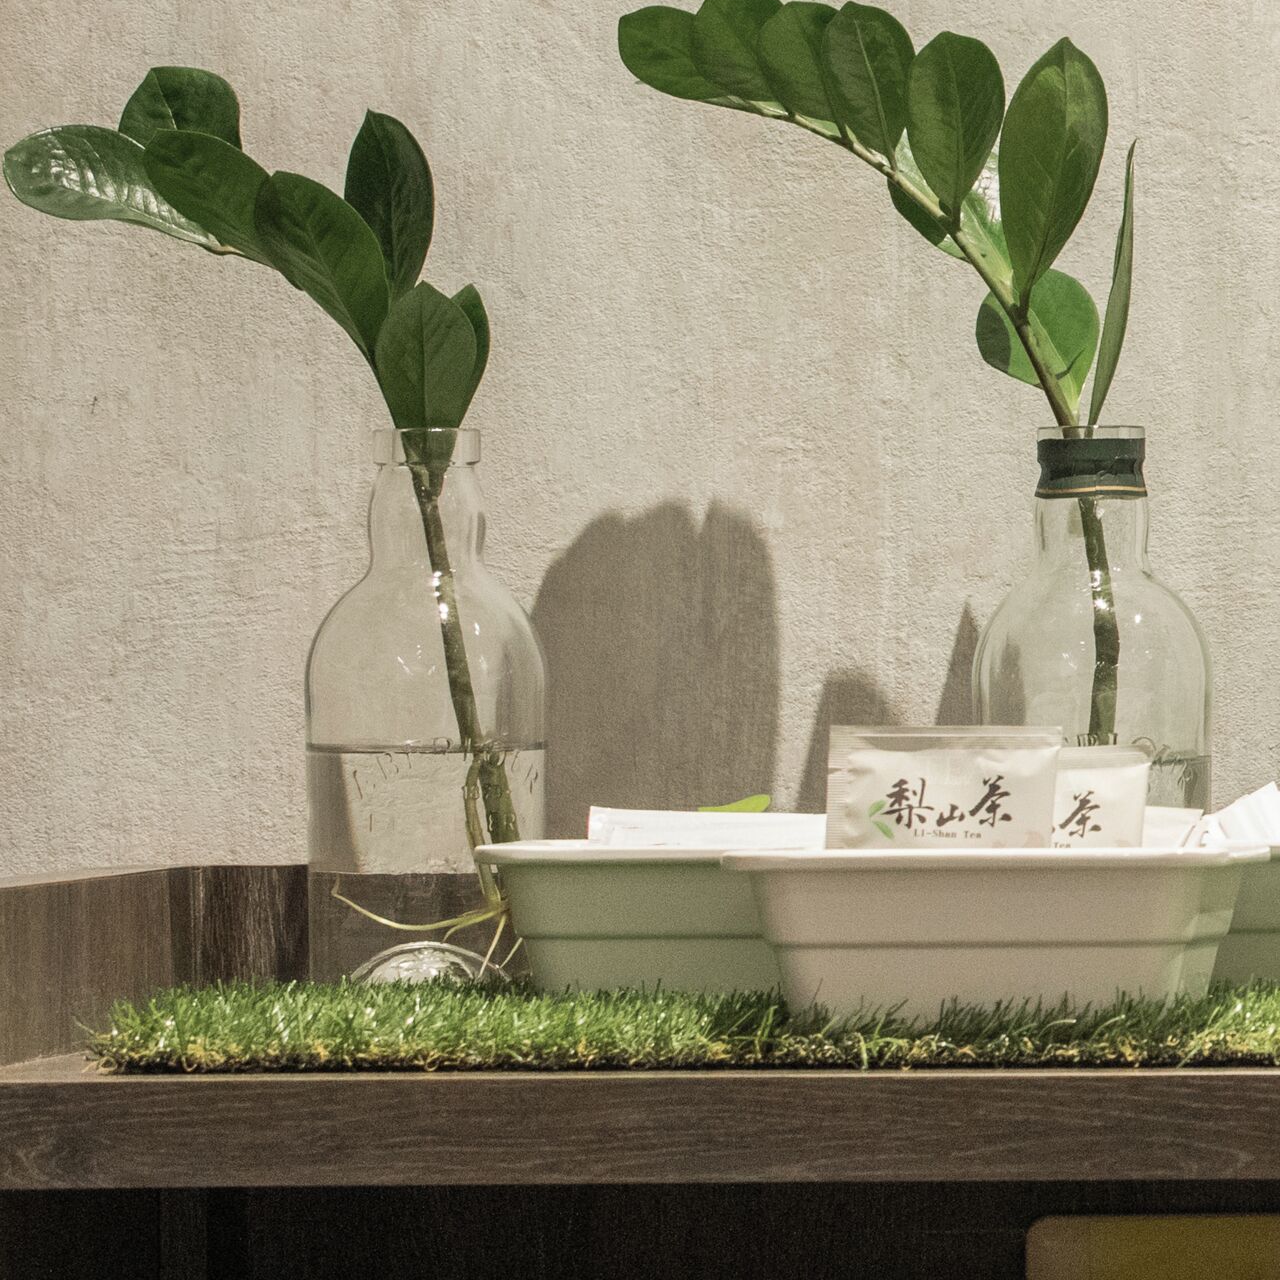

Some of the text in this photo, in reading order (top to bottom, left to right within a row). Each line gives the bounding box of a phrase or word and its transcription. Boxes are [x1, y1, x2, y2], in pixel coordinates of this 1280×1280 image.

[881, 775, 1013, 830] 梨山茶
[1052, 790, 1102, 838] 茶
[913, 828, 982, 839] Li-Shan Tea
